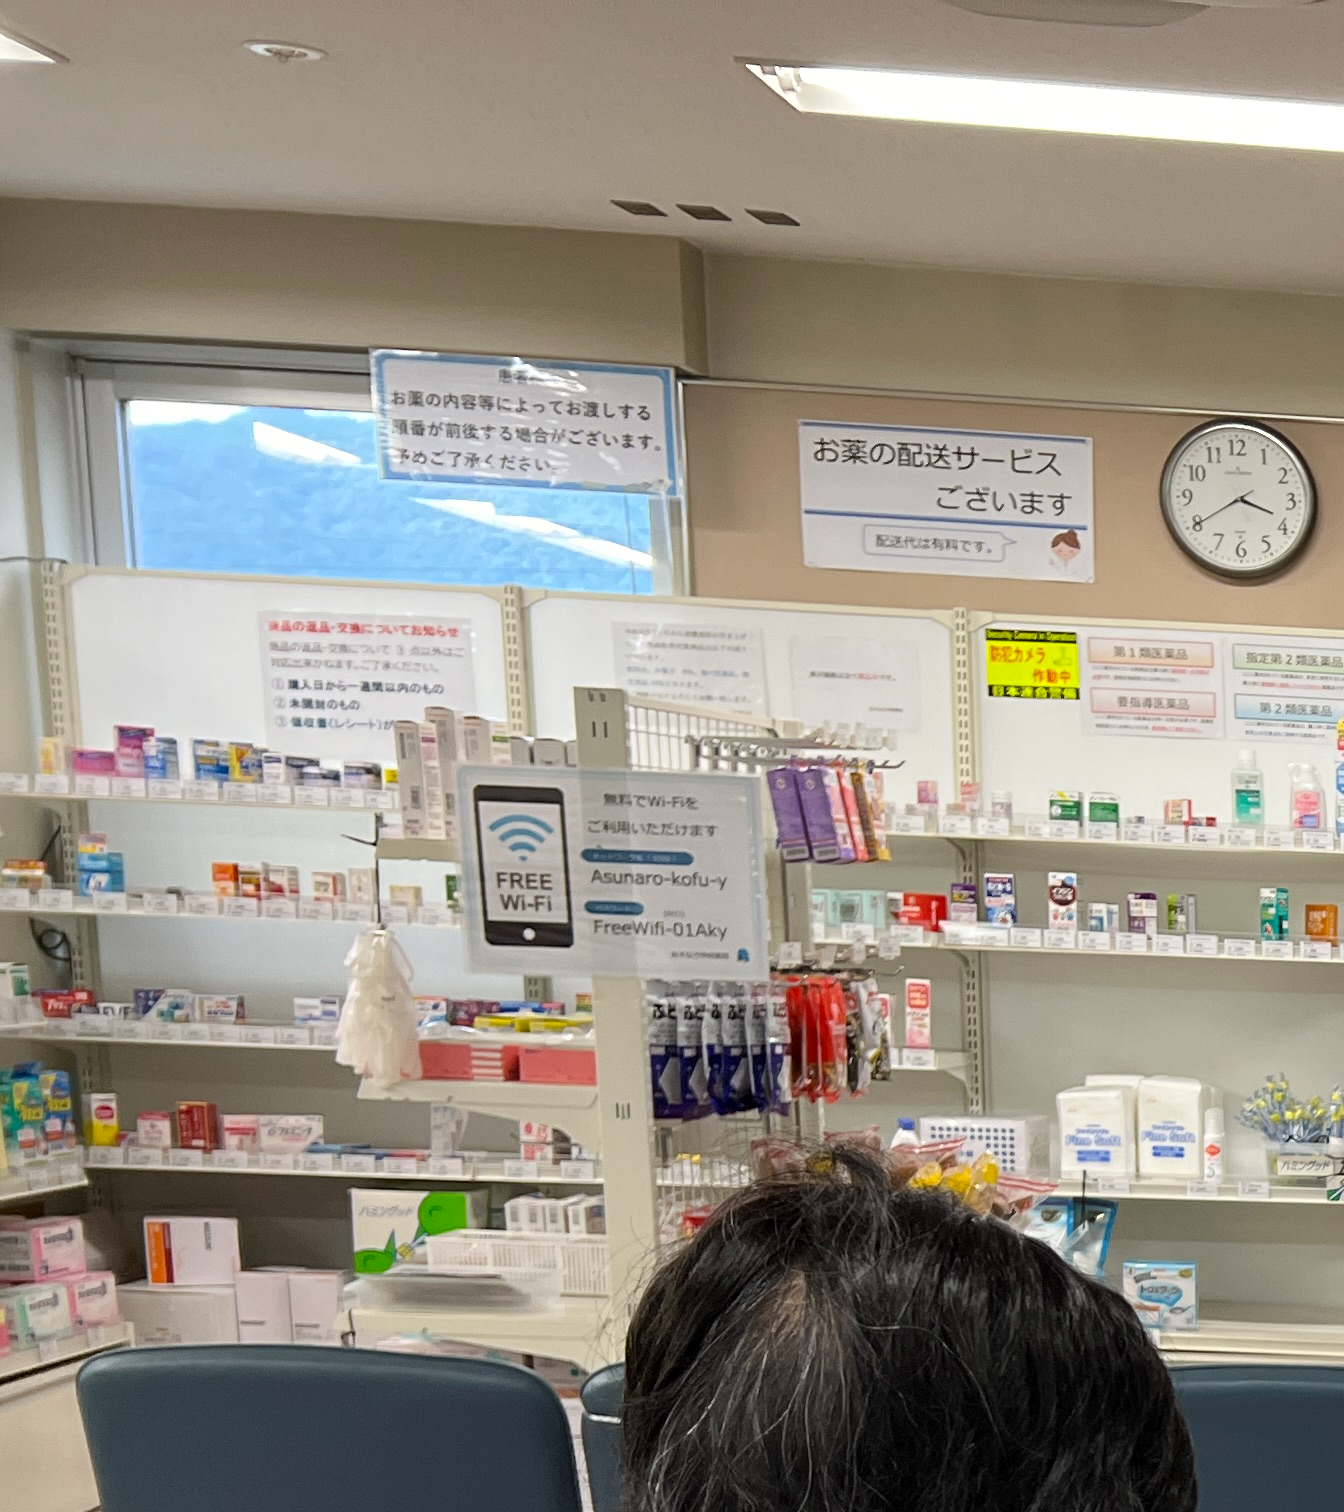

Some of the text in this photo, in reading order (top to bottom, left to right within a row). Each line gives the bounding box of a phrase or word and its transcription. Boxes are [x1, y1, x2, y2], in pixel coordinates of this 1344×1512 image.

[390, 390, 651, 421] お薬の内容等によってお渡しする
[1207, 446, 1221, 463] 11
[1228, 439, 1247, 456] 12
[1261, 448, 1267, 465] 1
[813, 438, 1062, 476] お薬の配送サービス
[1189, 464, 1206, 481] 10
[1278, 467, 1288, 484] 2
[936, 485, 1073, 516] ございます
[1182, 489, 1193, 506] 9
[1285, 492, 1296, 510] 3
[1192, 515, 1203, 532] 8
[1277, 517, 1288, 535] 4
[1213, 533, 1224, 550] 7
[1236, 540, 1247, 558] 6
[1262, 535, 1271, 553] 5
[587, 820, 718, 837] ご利用いただけます
[496, 871, 553, 891] FREE
[591, 868, 727, 891] Asunaro-kofu-y
[500, 893, 552, 913] Wi-Fi
[593, 919, 727, 941] FreeWifi-01Aky
